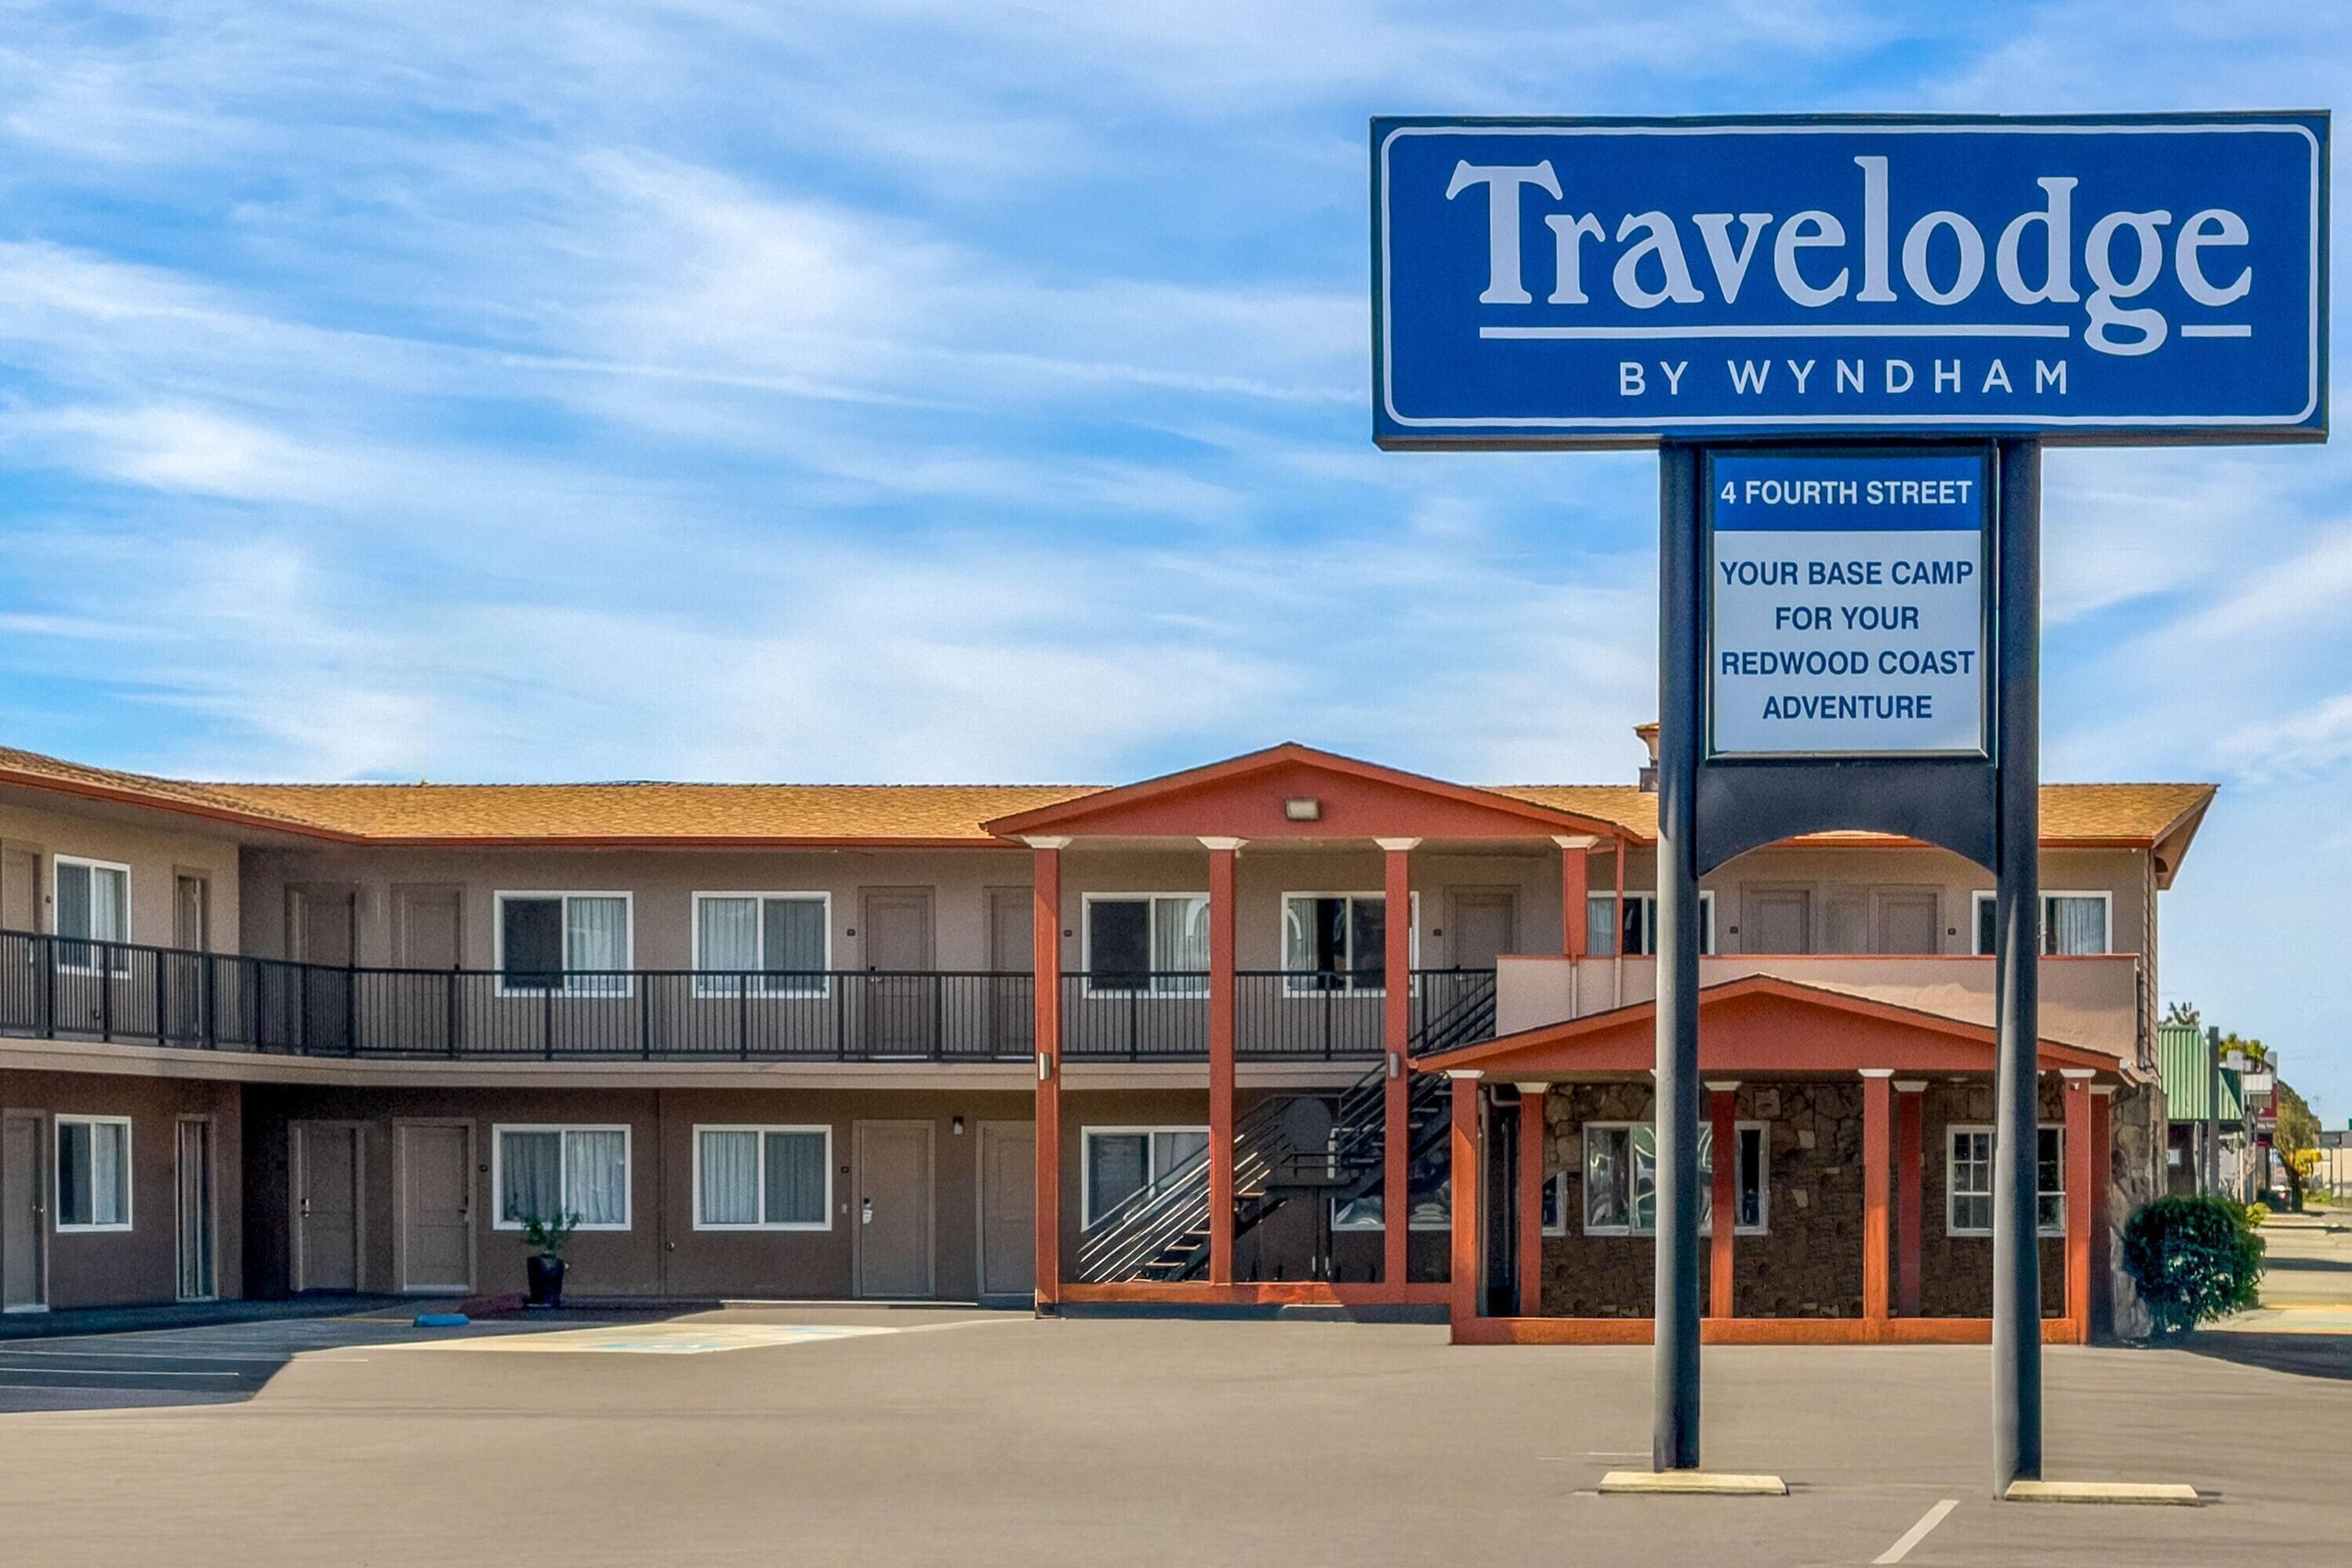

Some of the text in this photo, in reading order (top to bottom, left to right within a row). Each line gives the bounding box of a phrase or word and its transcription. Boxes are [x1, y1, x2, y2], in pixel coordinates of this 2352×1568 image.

[1446, 156, 2252, 356] Travelodge
[1620, 359, 2067, 396] BY WYNDHAM
[1720, 480, 1973, 504] 4 FOURTH STREET
[1720, 561, 1973, 586] YOUR BASE CAMP
[1776, 606, 1919, 630] FOR YOUR
[1722, 650, 1975, 675] REDWOOD COAST
[1762, 695, 1933, 720] ADVENTURE
